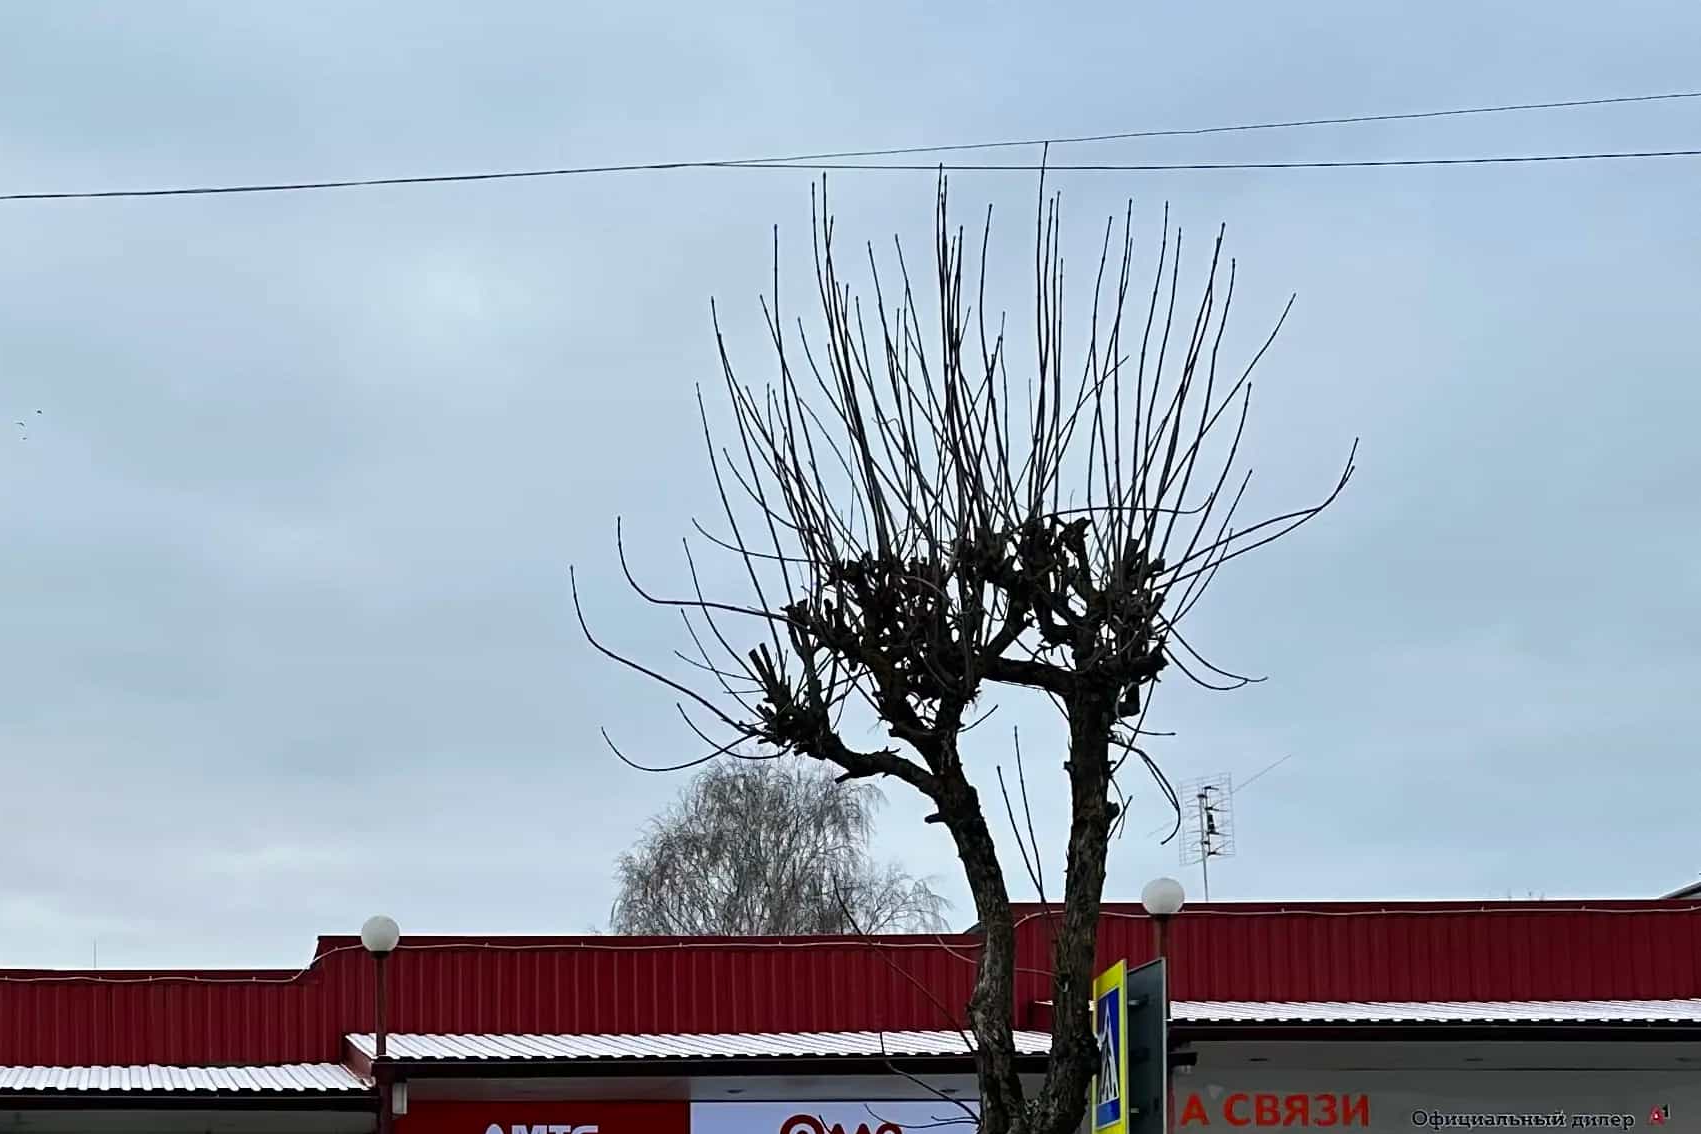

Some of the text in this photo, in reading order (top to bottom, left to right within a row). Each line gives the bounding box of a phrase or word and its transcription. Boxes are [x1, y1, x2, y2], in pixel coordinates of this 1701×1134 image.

[1223, 1093, 1369, 1127] СВЯЗИ
[1411, 1109, 1635, 1131] Официальный дилер
